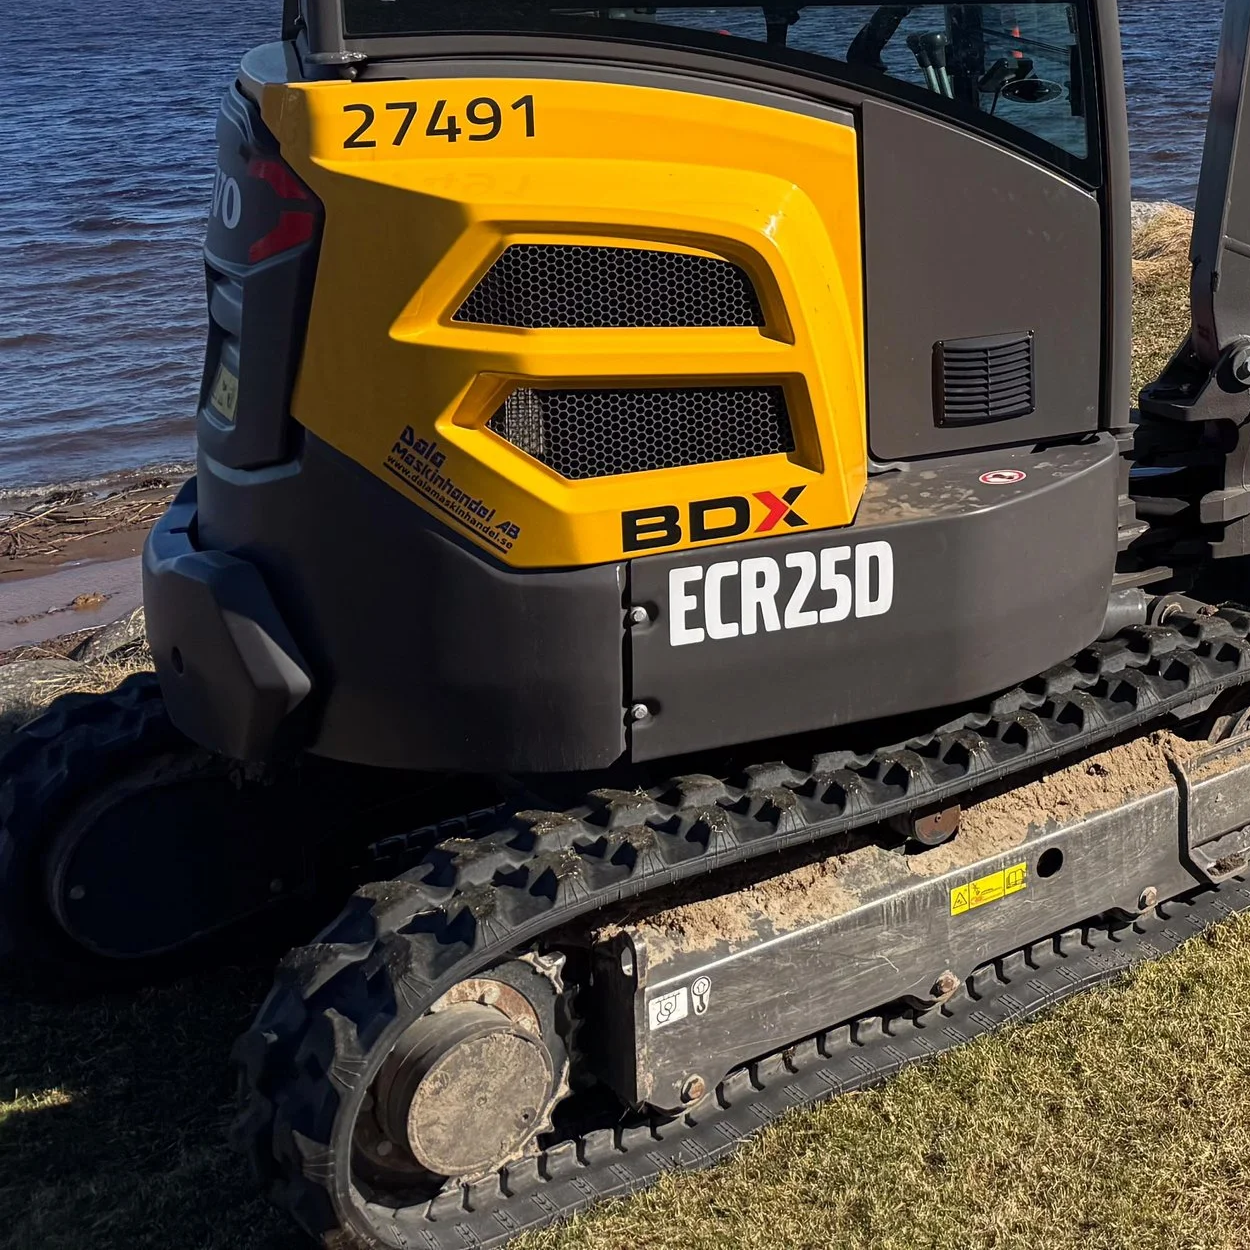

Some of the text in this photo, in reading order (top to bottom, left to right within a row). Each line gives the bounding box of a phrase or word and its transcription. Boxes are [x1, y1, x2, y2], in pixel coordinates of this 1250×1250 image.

[343, 95, 534, 148] 27491
[400, 424, 446, 468] Dala
[387, 455, 513, 550] www.dalamaskinhandel.se
[391, 442, 521, 539] Maskinhandel AB
[621, 484, 808, 553] BDX
[668, 540, 894, 647] ECR25D
